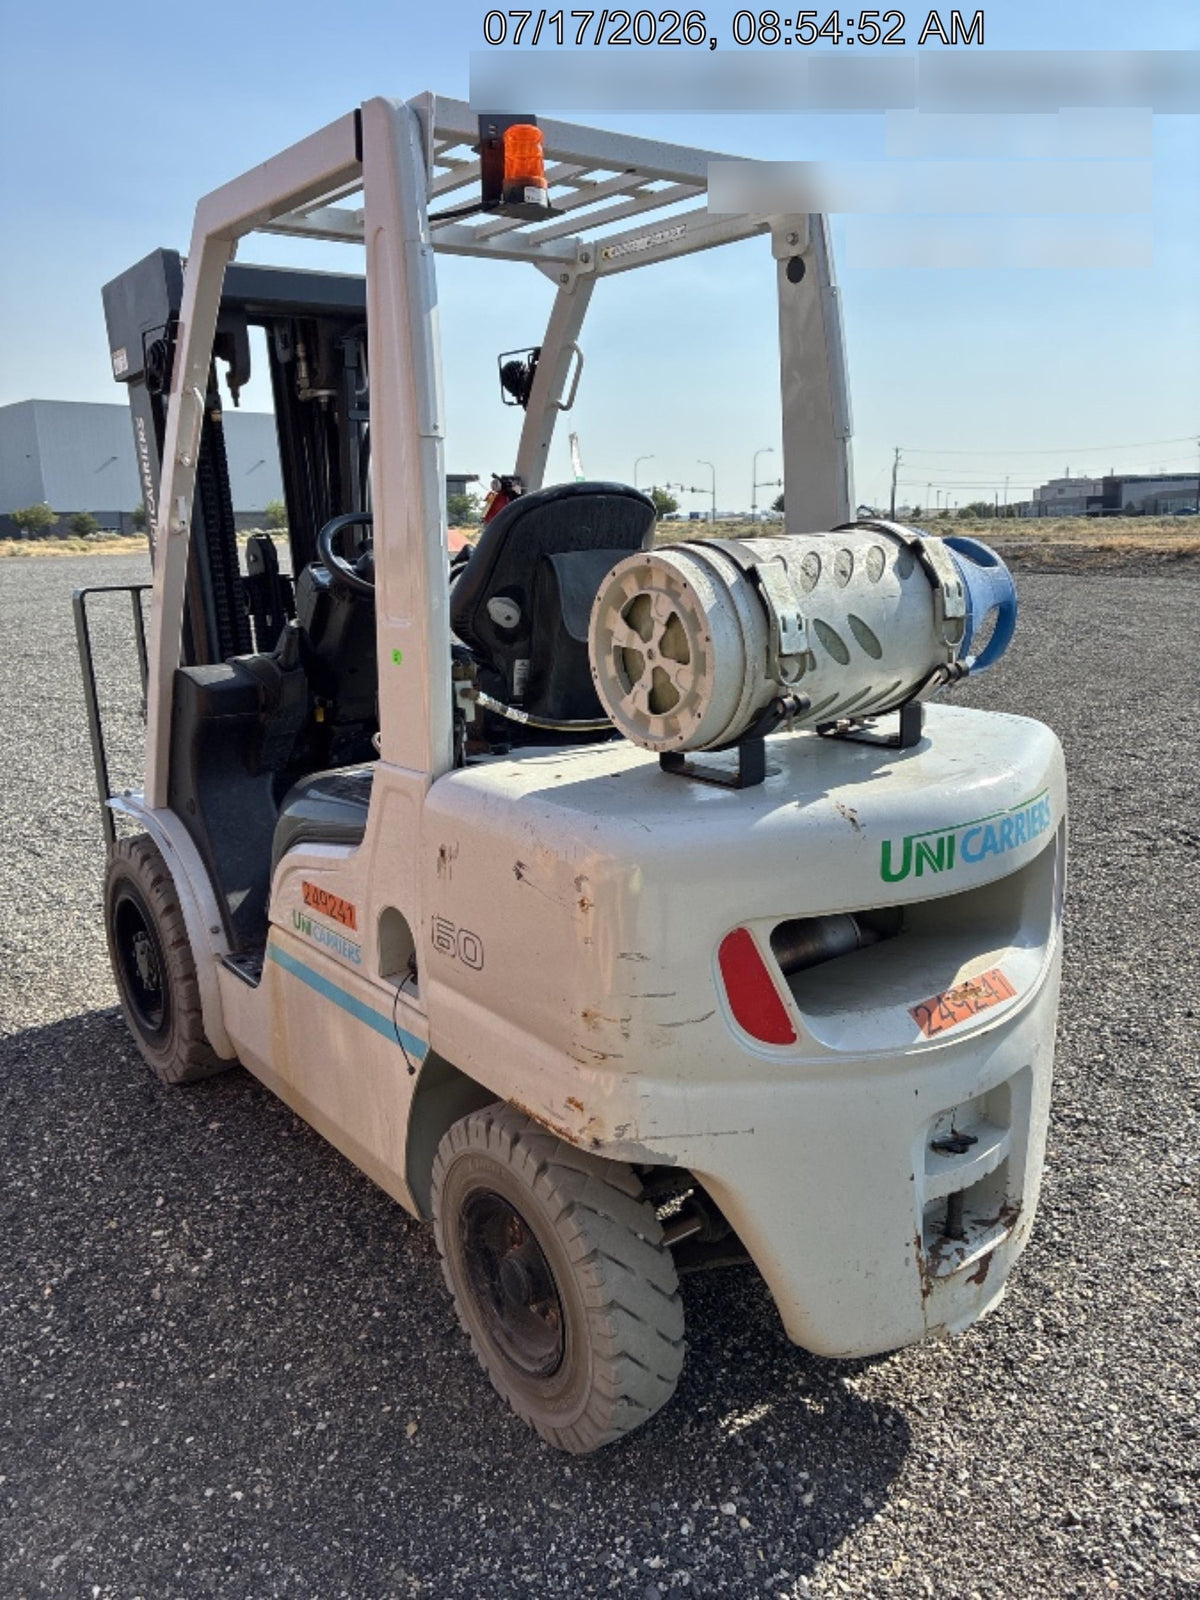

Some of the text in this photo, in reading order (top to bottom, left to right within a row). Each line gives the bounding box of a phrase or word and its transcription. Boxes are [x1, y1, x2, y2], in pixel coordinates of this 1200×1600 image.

[303, 881, 356, 931] 249241
[431, 914, 484, 971] 60
[913, 968, 1014, 1036] 249241
